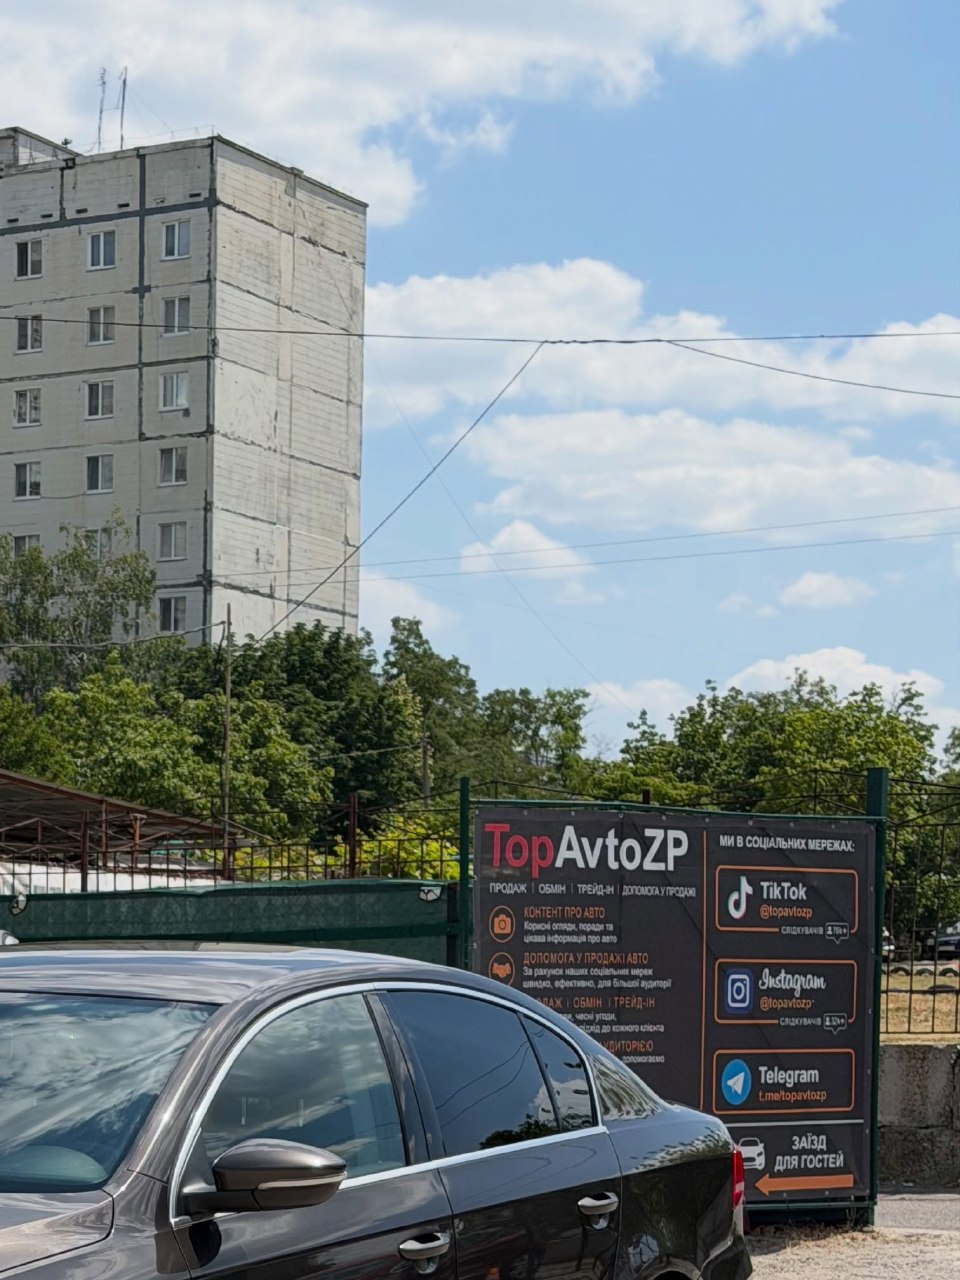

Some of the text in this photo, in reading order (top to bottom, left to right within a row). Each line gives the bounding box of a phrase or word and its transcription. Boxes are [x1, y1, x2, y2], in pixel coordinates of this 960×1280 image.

[719, 834, 855, 851] МИ В СОЦІАЛЬНИХ МЕРЕЖАХ:
[484, 823, 689, 879] TopAvtoZP
[490, 883, 527, 895] ПРОДАЖ
[538, 883, 566, 894] ОБМІН
[577, 882, 614, 896] ТРЕЙД-ІН
[622, 885, 659, 897] ДОПОМОГА
[760, 881, 807, 900] TikTok
[523, 906, 605, 919] КОНТЕНТ ПРО АВТО
[759, 904, 813, 920] @topavtozp
[605, 923, 614, 931] та
[587, 935, 600, 944] про
[601, 935, 618, 943] авто
[522, 952, 573, 965] ДОПОМОГА
[575, 953, 583, 964] У
[626, 953, 649, 964] АВТО
[522, 966, 533, 976] За
[597, 980, 612, 989] для
[758, 967, 827, 998] Instagram
[573, 997, 602, 1009] ОБМІН
[613, 995, 655, 1010] ТРЕЙД-ІН
[600, 1040, 654, 1053] УДИТОРІЄЮ
[758, 1065, 819, 1088] Telegram
[758, 1089, 827, 1103] t.me/topavtozp
[791, 1133, 827, 1150] ЗАЇЗД
[774, 1151, 844, 1172] ДЛЯ ГОСТЕЙ
